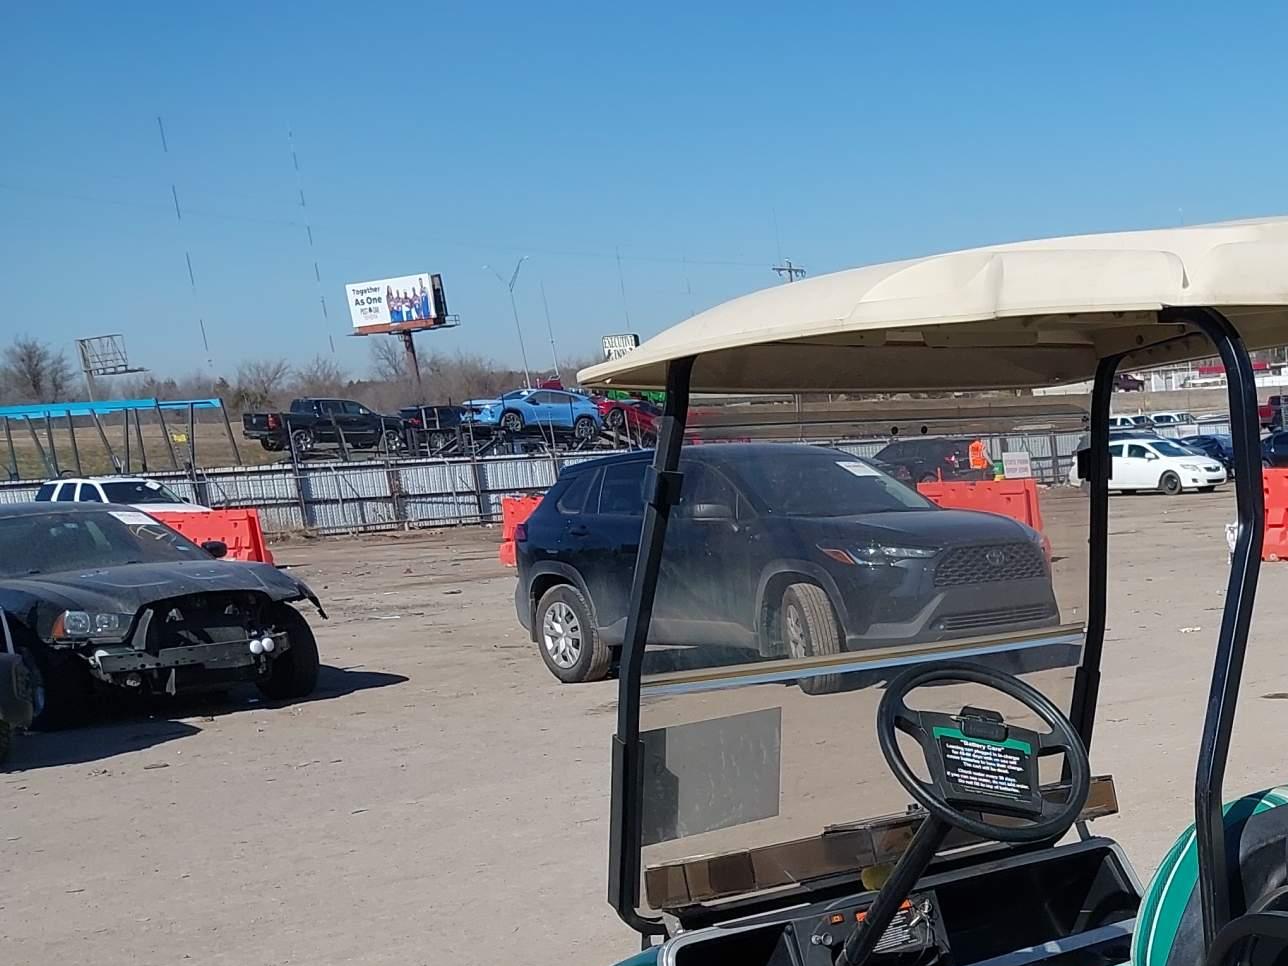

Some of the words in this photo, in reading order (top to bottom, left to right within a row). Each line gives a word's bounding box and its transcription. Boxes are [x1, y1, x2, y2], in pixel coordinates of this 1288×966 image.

[352, 286, 380, 296] Together
[354, 298, 365, 306] As
[366, 296, 382, 305] One
[604, 336, 634, 348] EXECUTIVE
